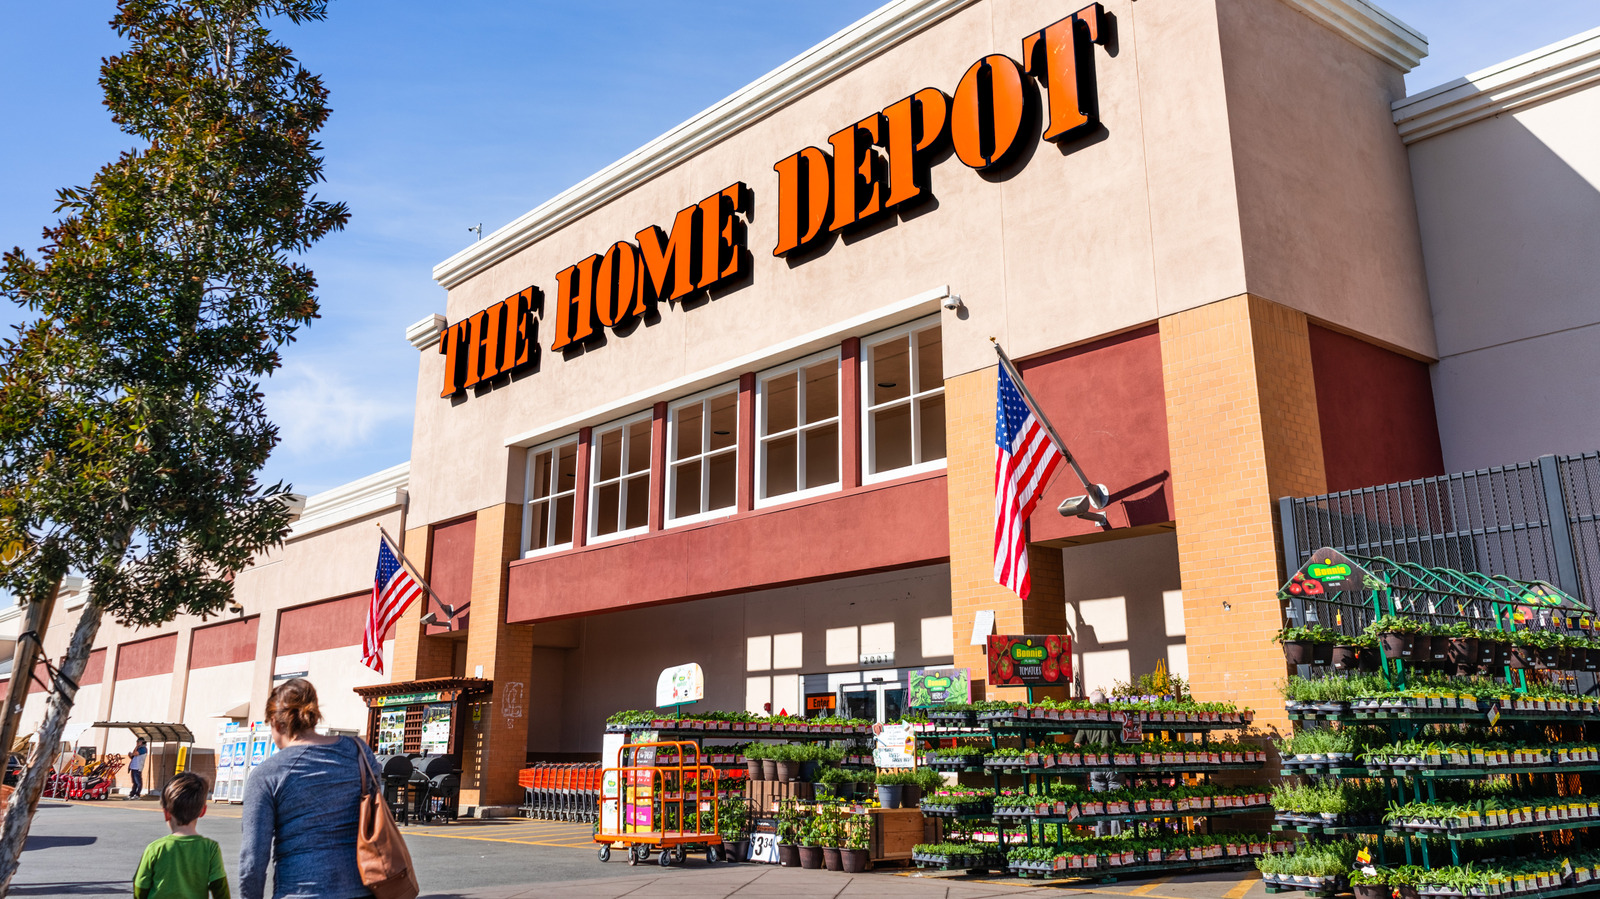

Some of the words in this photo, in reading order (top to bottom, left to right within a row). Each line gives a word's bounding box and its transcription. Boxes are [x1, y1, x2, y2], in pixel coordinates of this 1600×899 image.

[438, 286, 536, 398] THE
[551, 181, 743, 352] HOME
[773, 2, 1102, 258] DEPOT
[1314, 566, 1346, 577] Bonnie
[1016, 648, 1043, 658] Bonnie
[863, 654, 888, 665] 2001
[1018, 666, 1042, 676] TOMATOES
[927, 679, 948, 687] Bonnie
[813, 698, 830, 708] Enter
